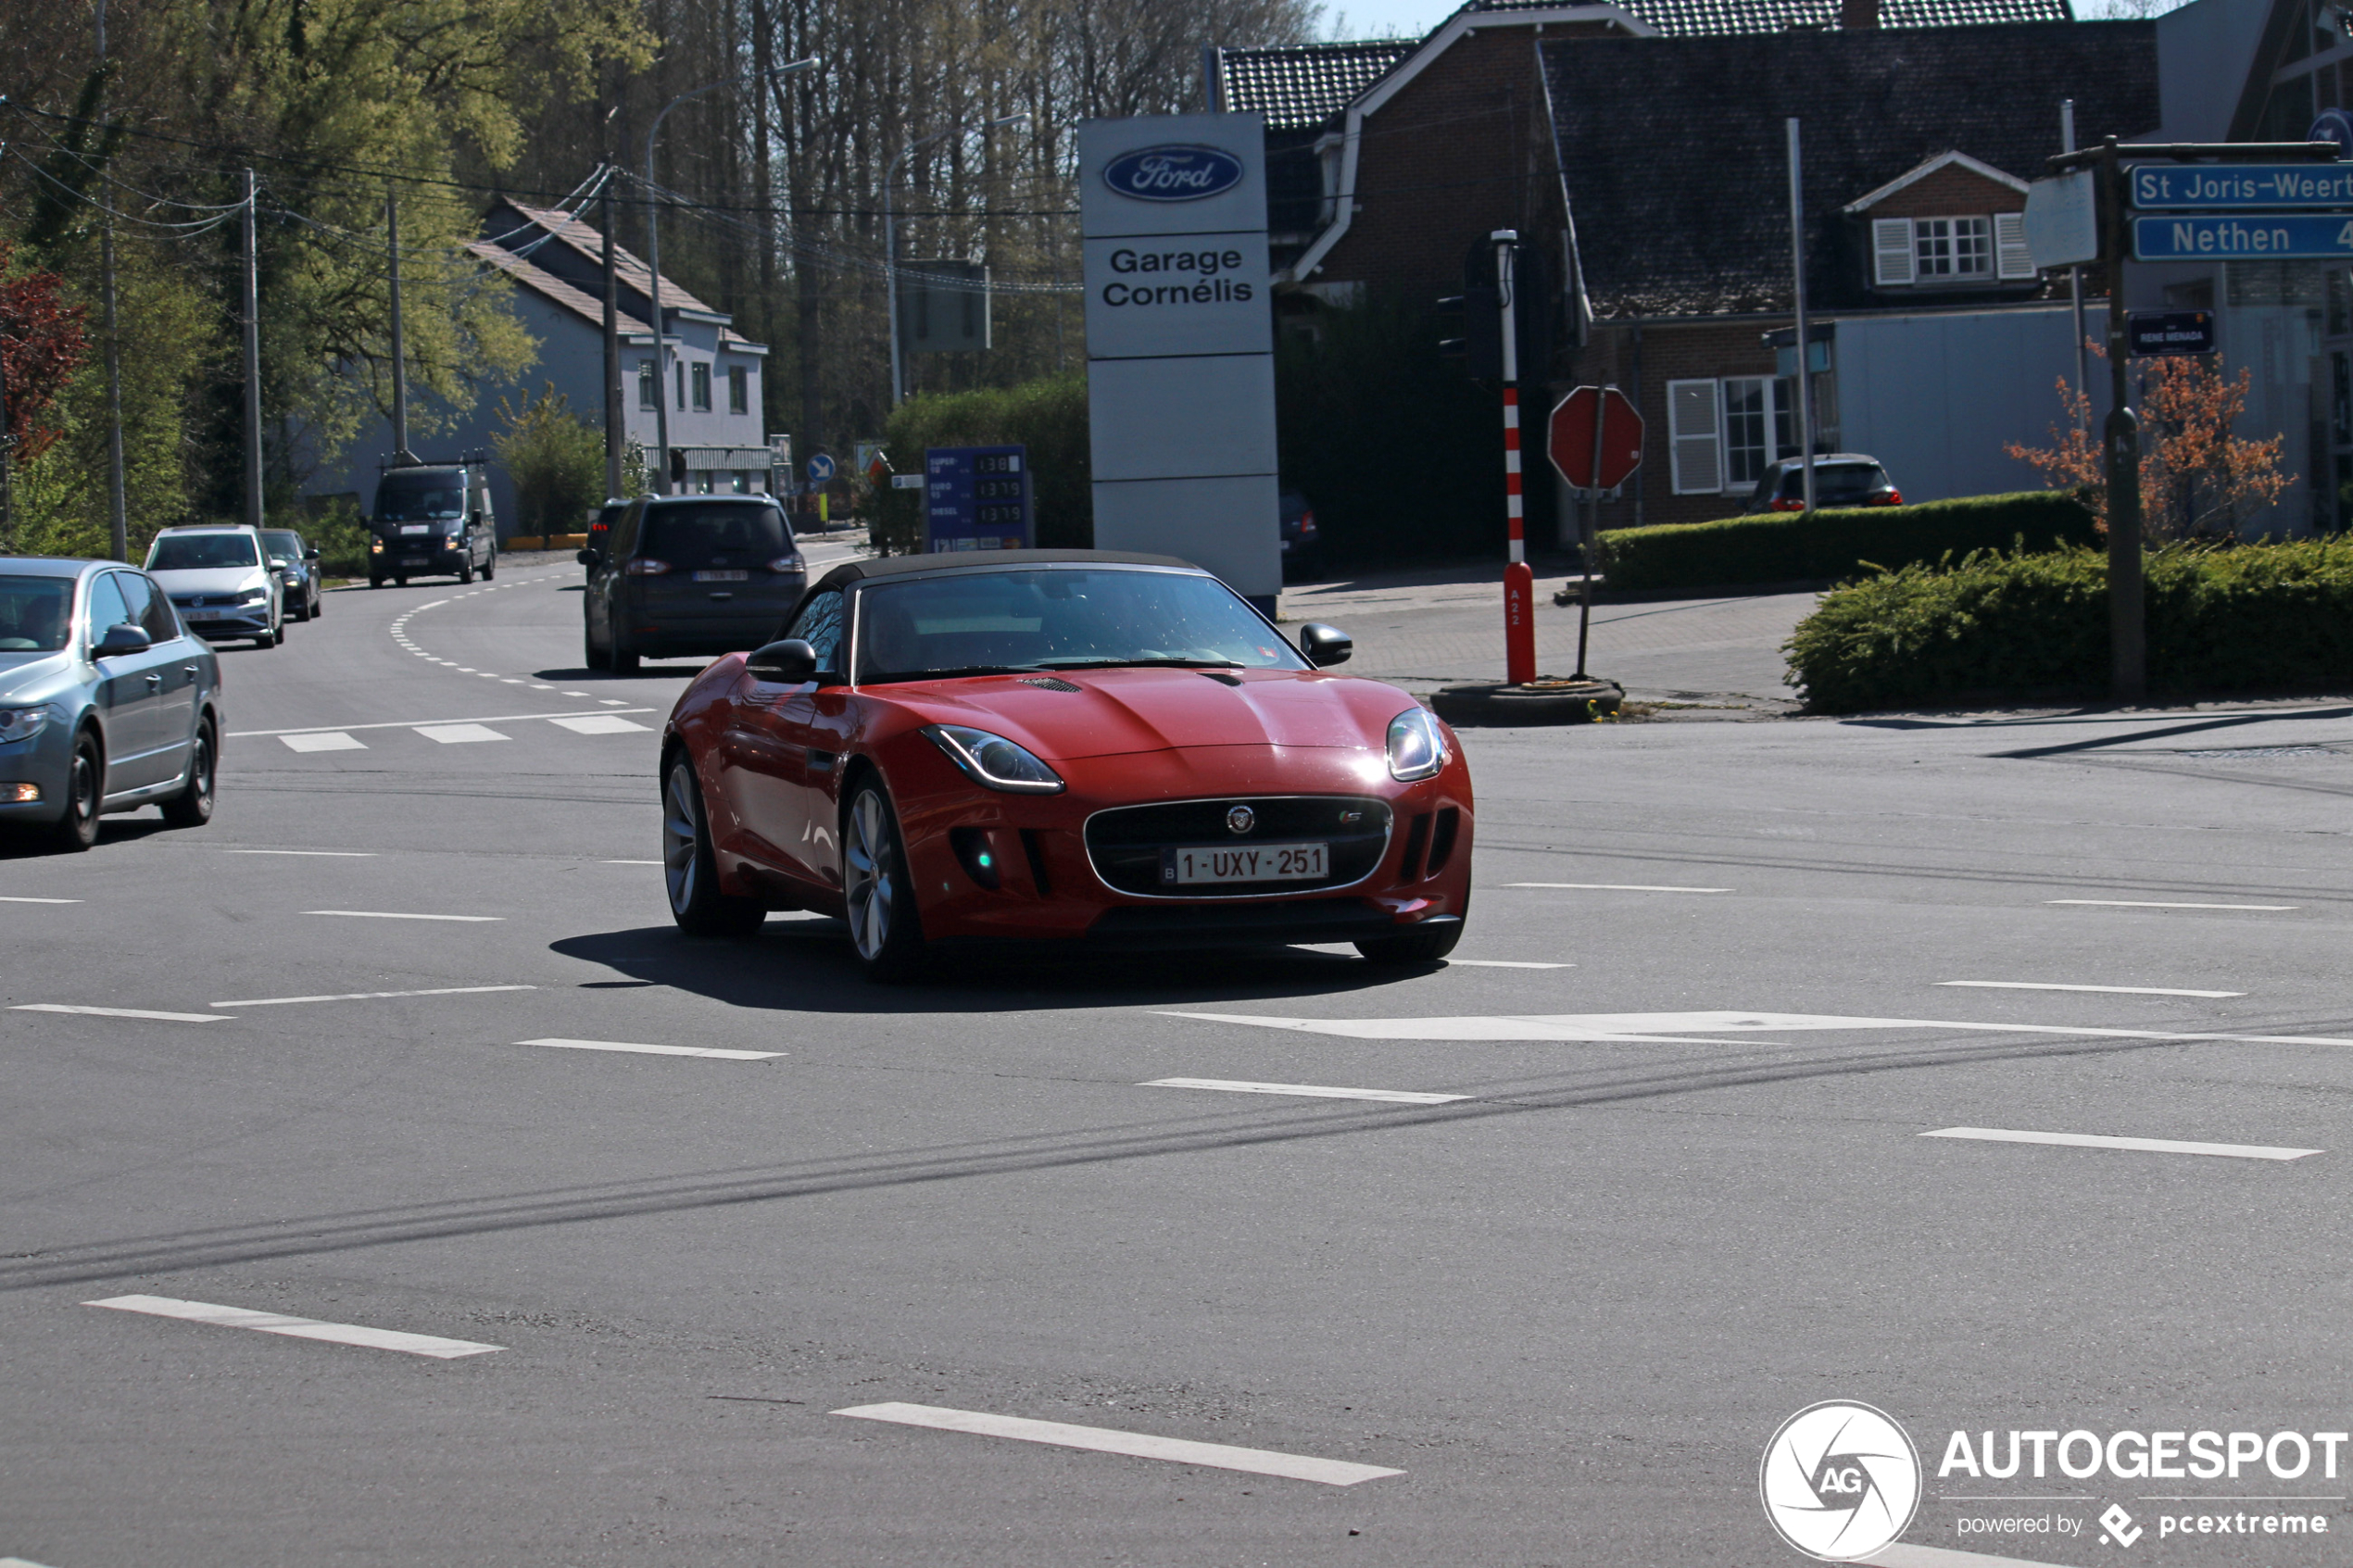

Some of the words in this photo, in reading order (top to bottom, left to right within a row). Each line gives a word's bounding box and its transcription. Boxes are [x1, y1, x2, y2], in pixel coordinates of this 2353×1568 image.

[1132, 155, 1215, 189] Ford
[2140, 174, 2171, 199] St
[2172, 221, 2290, 252] Nethen
[2336, 220, 2353, 248] 4
[1110, 248, 1242, 276] Garage
[1102, 278, 1253, 307] Cornélis
[930, 483, 952, 491] EURO
[931, 507, 958, 516] DIESEL
[1164, 868, 1175, 879] B
[1183, 848, 1322, 879] 1-UXY-251
